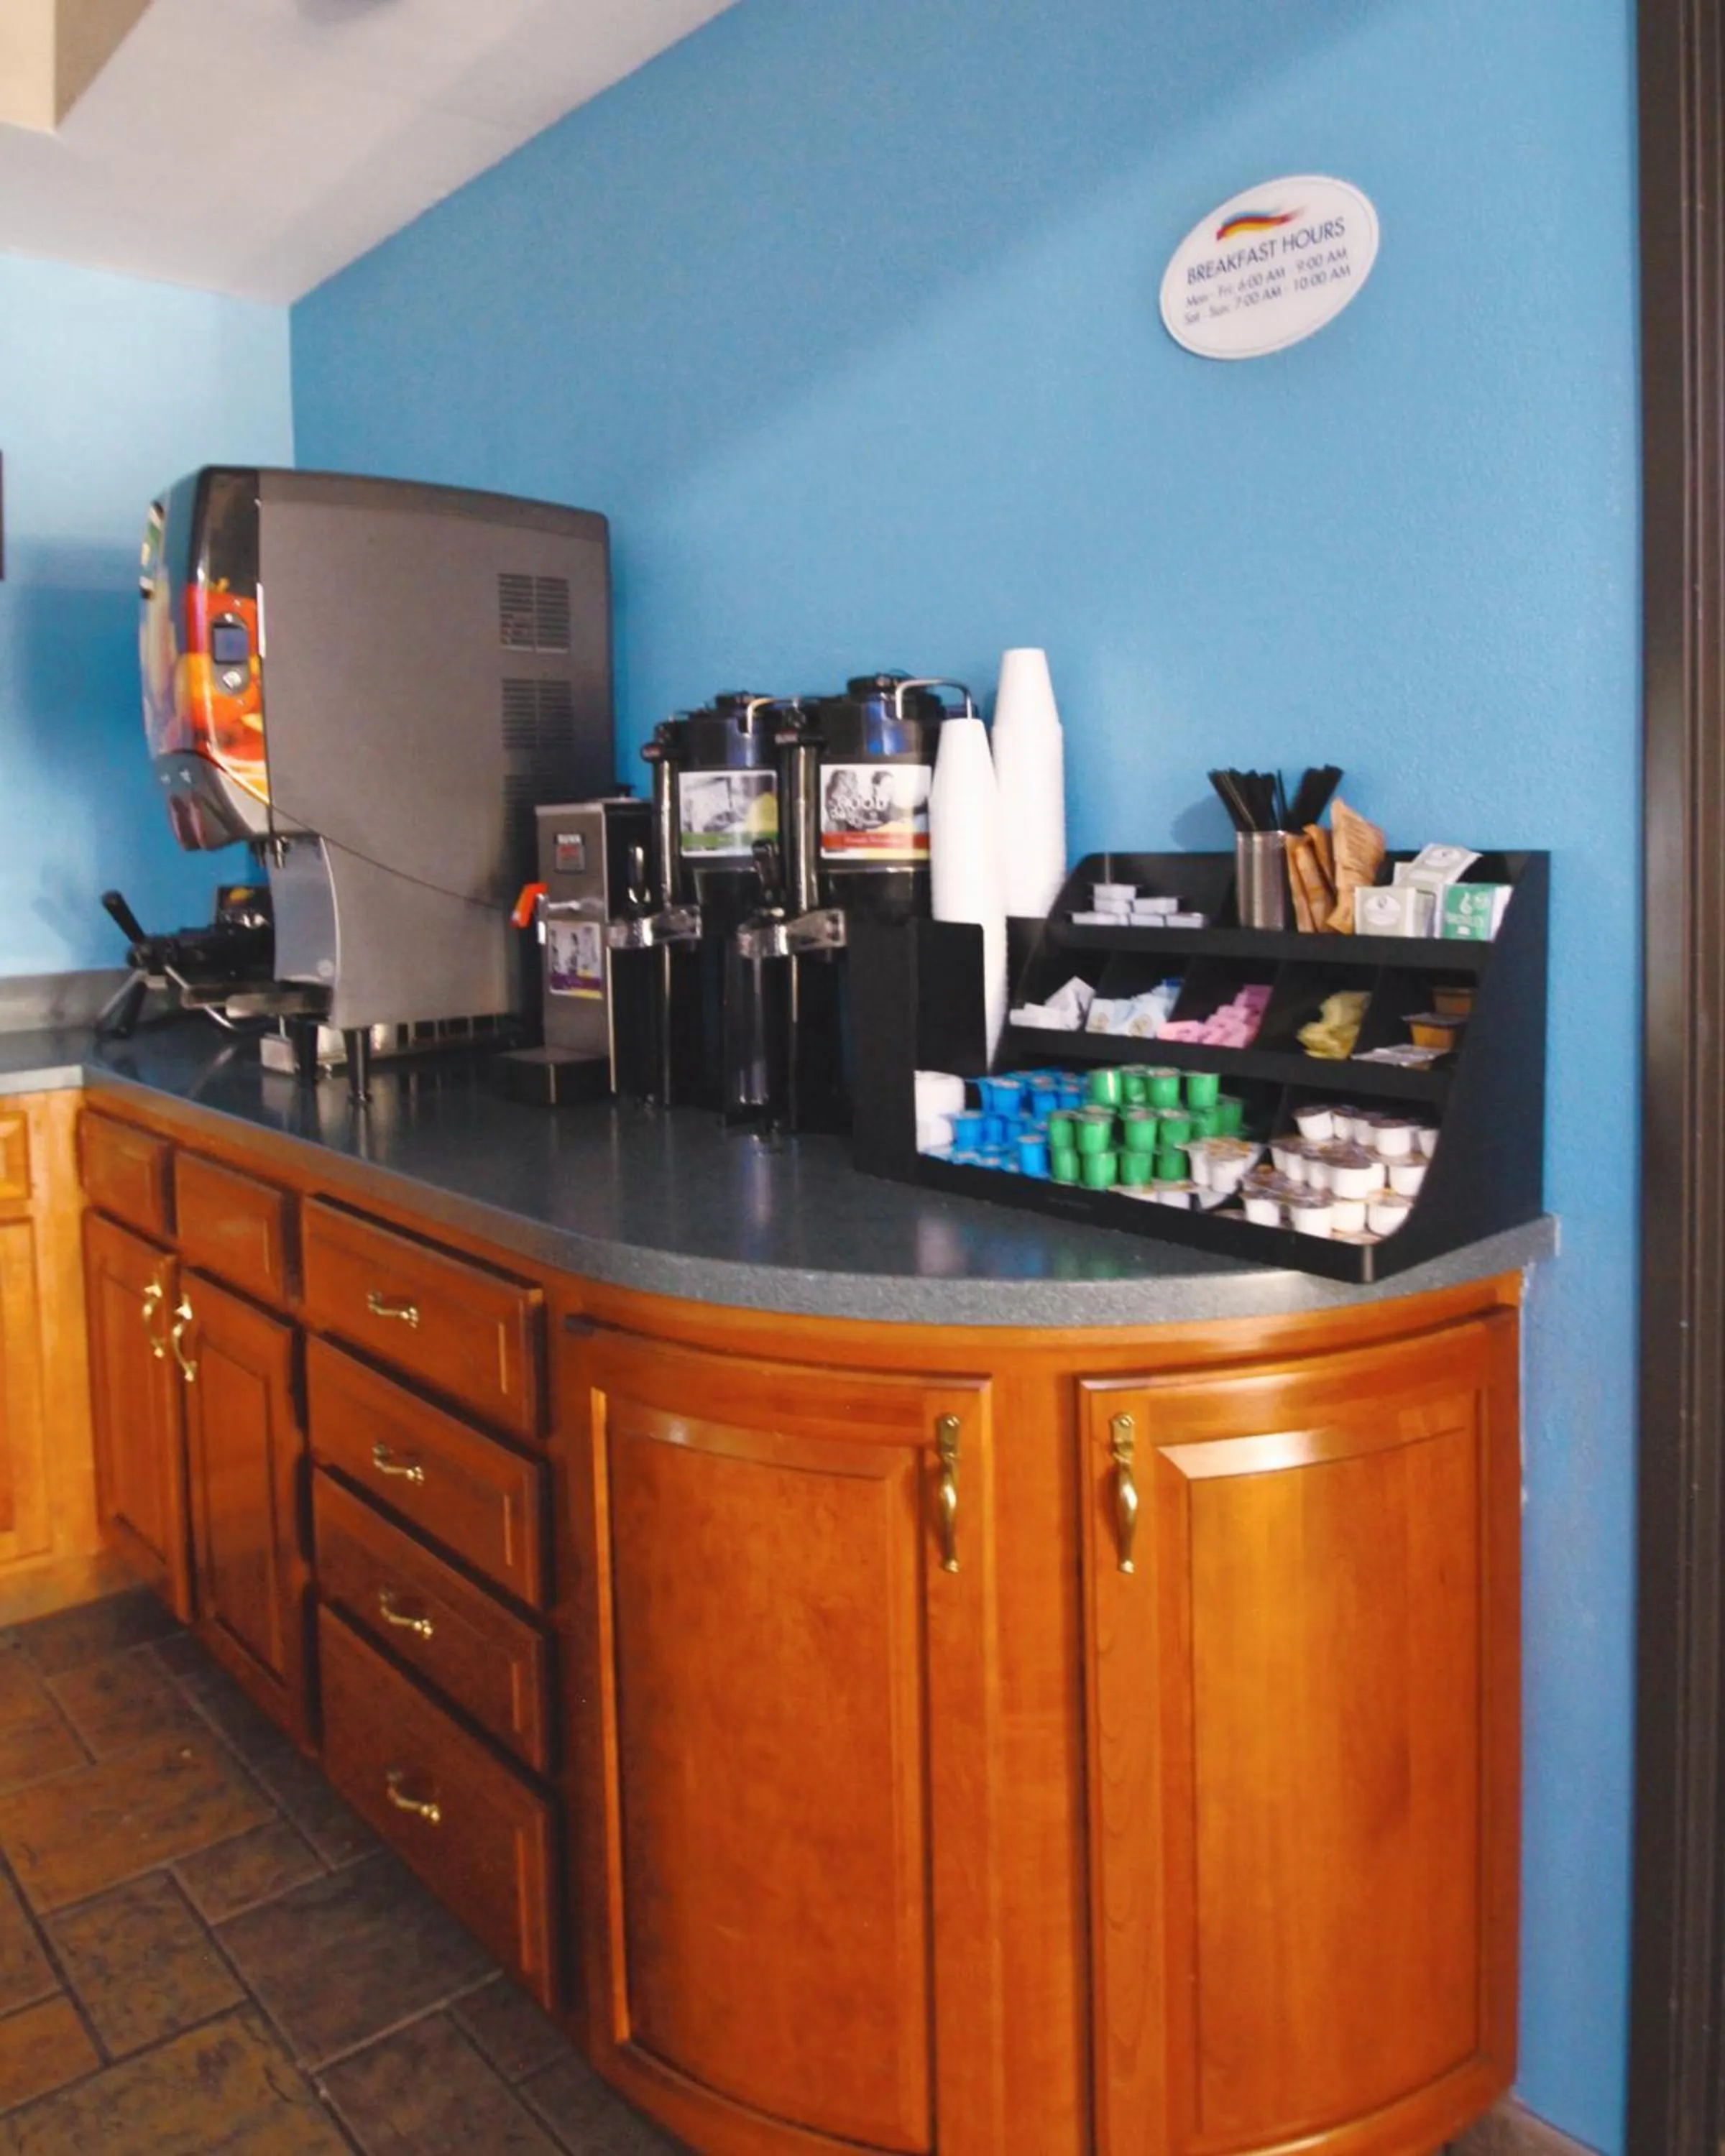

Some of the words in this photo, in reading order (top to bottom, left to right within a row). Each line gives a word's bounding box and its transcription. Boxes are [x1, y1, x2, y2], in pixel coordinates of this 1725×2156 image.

[1187, 239, 1277, 285] BREAKFAST
[1282, 216, 1346, 254] HOURS
[1266, 266, 1285, 284] AM
[1328, 246, 1348, 265] AM
[1263, 285, 1282, 300] AM
[1330, 264, 1351, 283] AM
